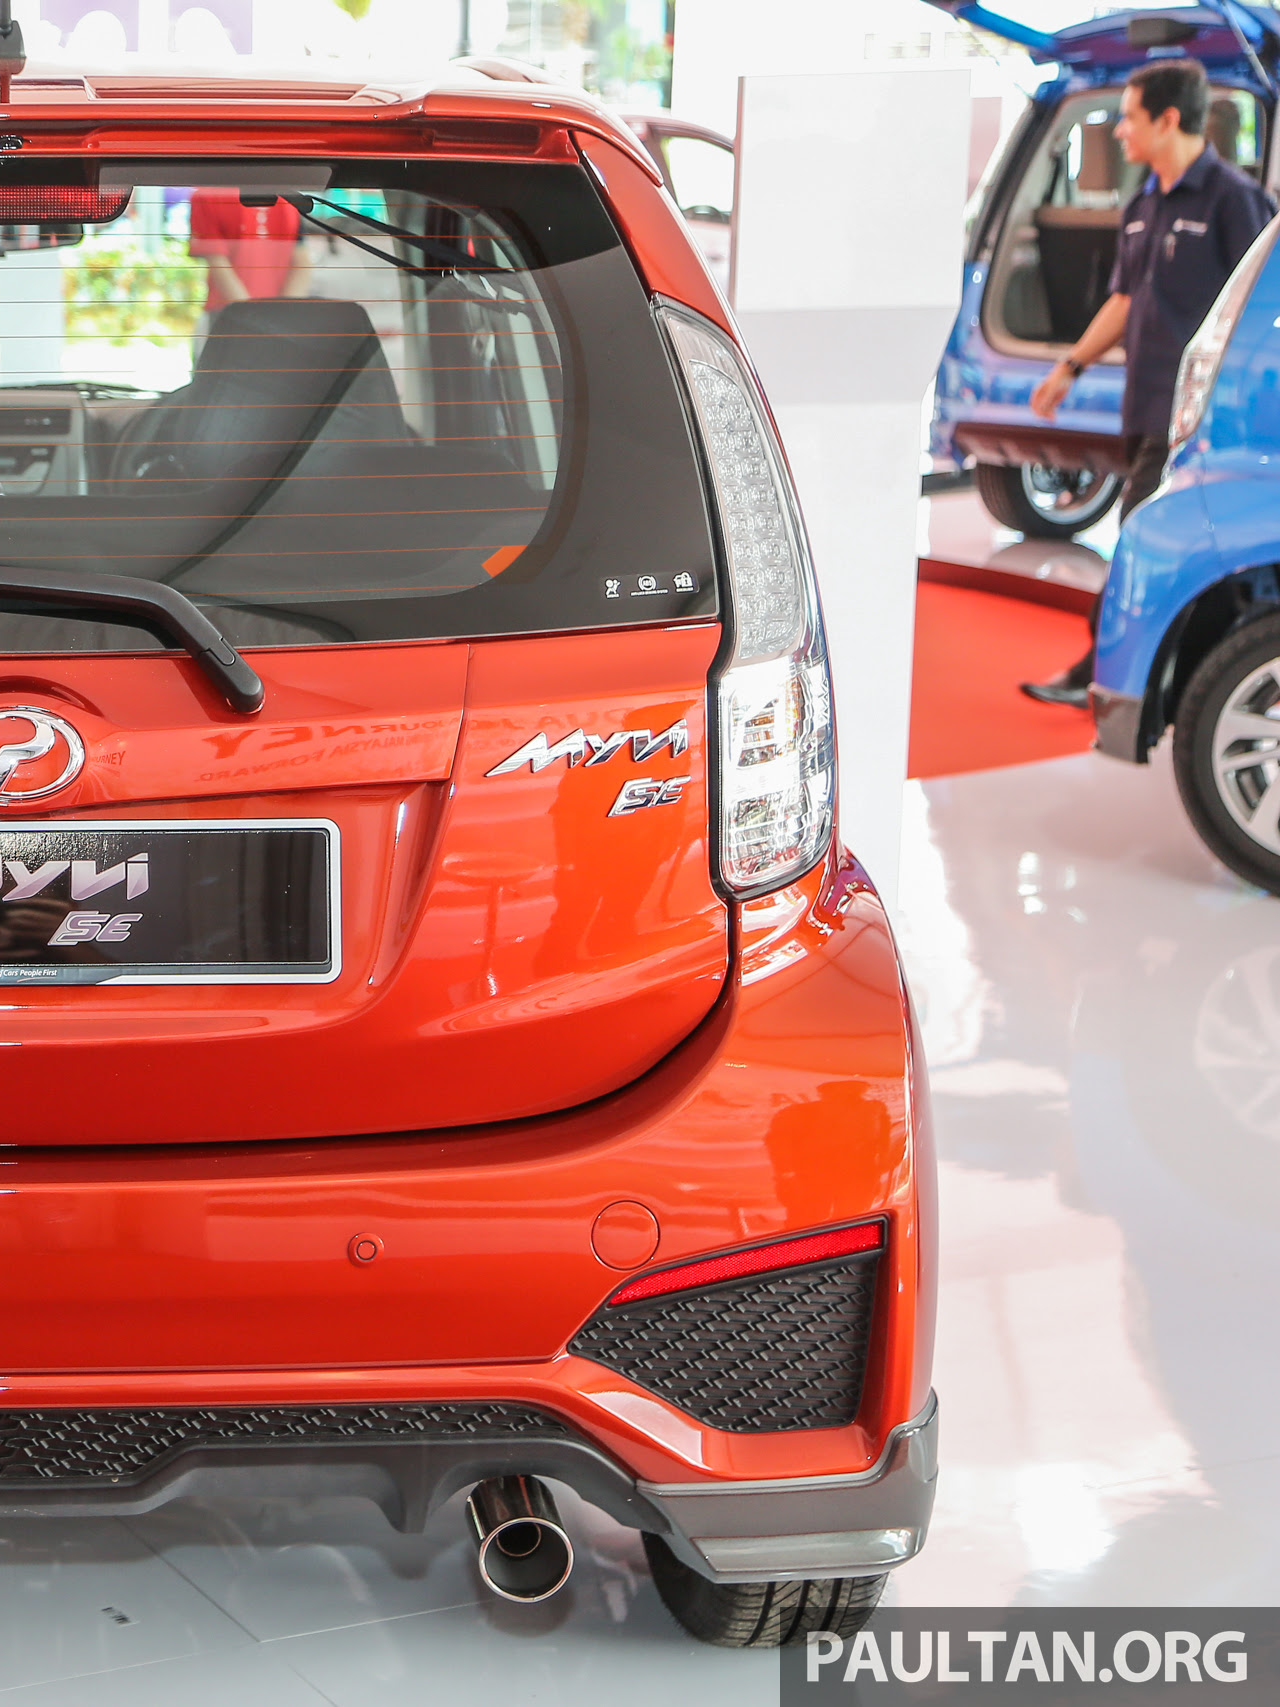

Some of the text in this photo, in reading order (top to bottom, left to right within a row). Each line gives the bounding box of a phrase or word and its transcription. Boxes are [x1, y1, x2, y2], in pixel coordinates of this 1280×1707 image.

[47, 910, 143, 946] SE
[3, 969, 18, 977] Cars
[20, 969, 42, 978] People
